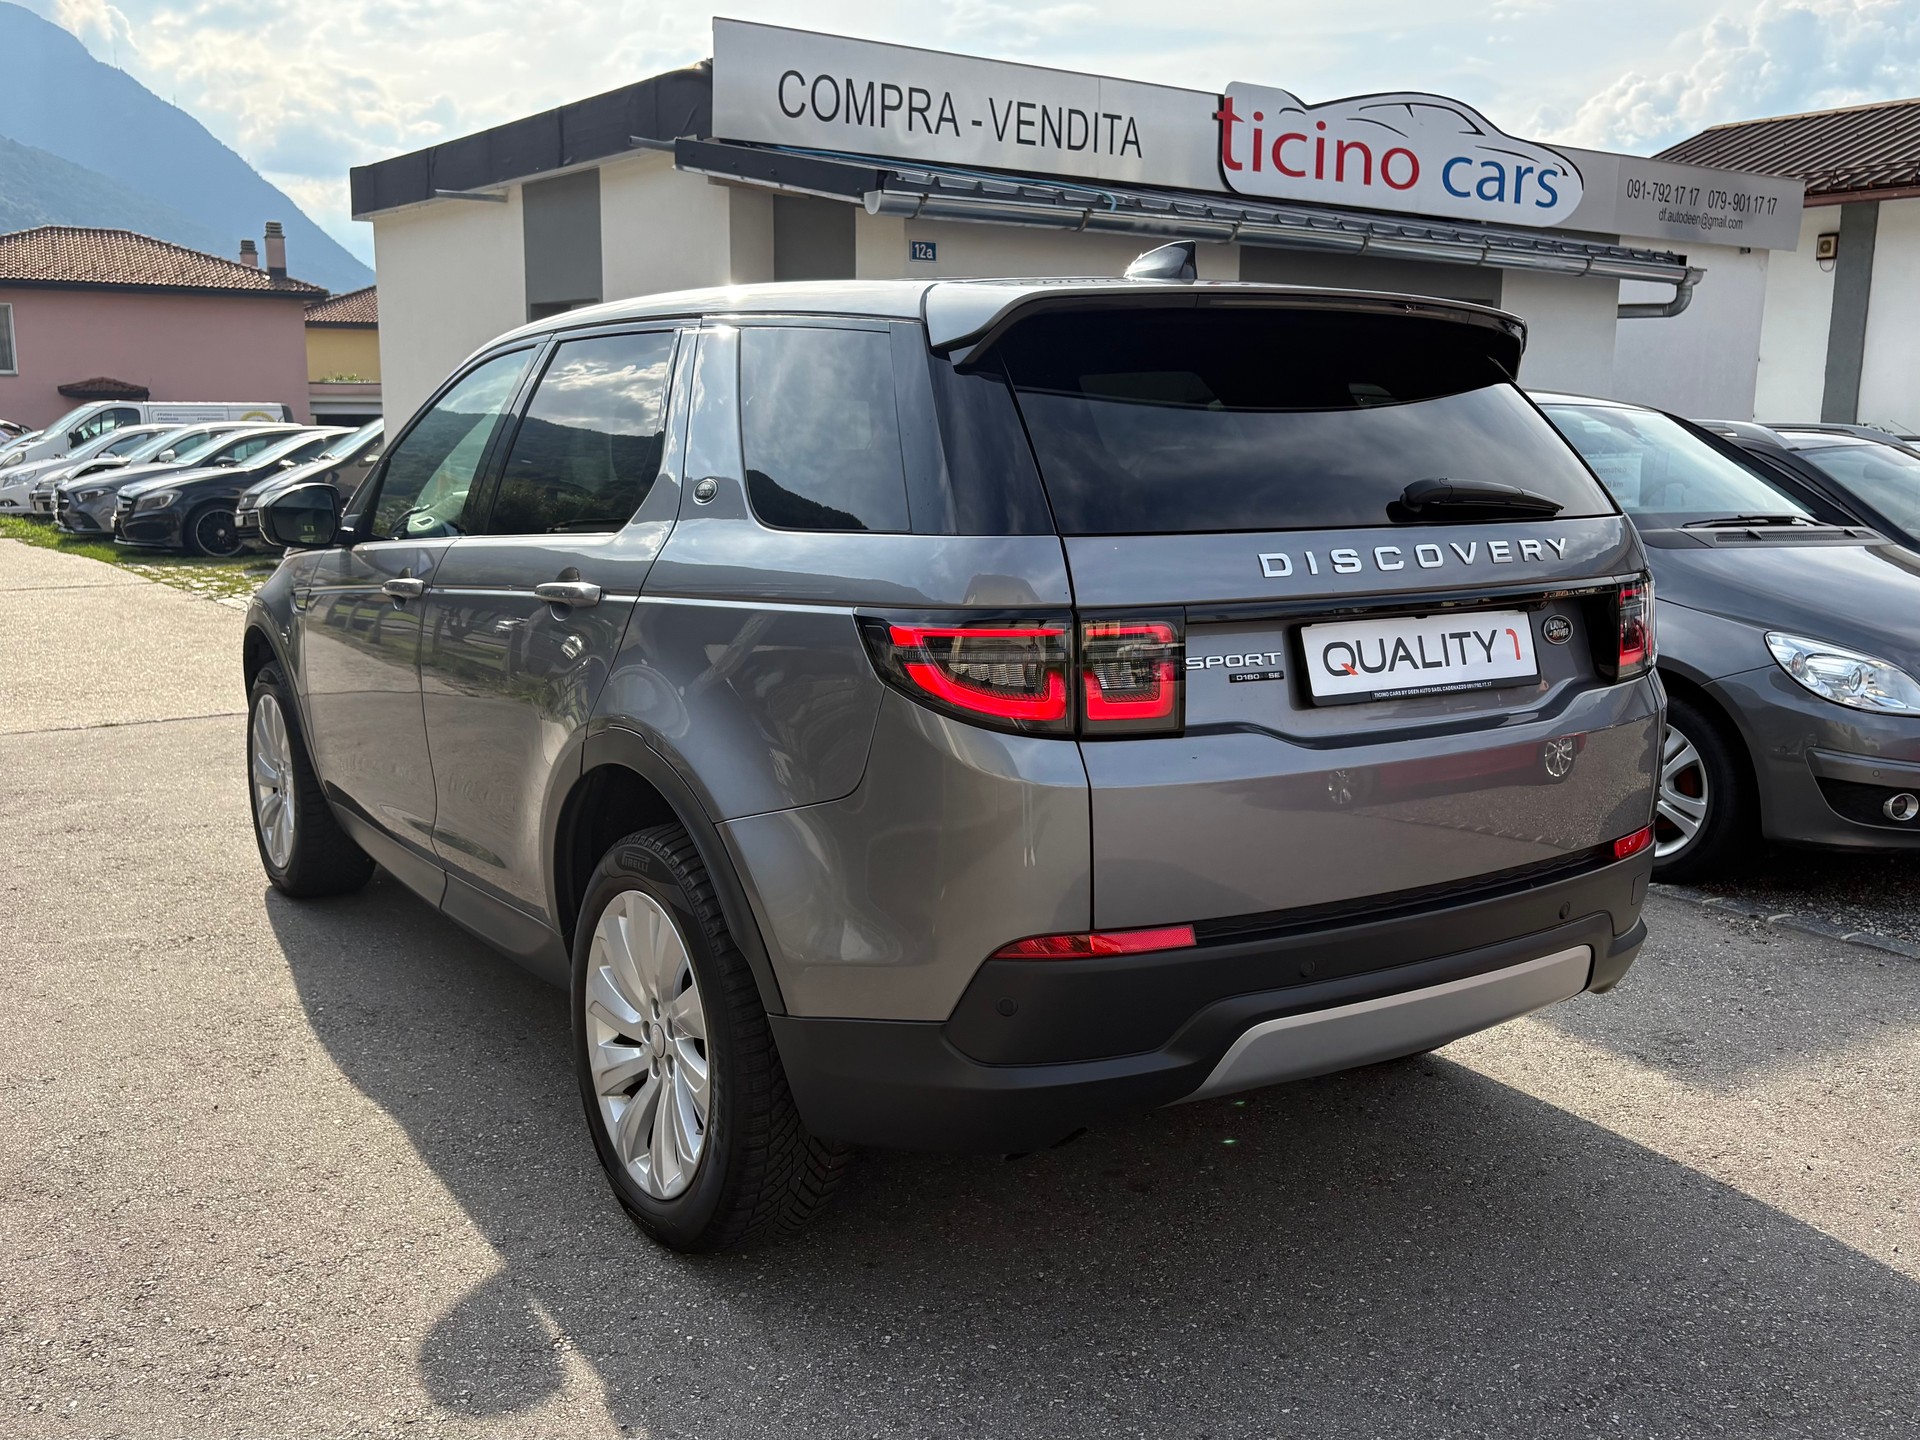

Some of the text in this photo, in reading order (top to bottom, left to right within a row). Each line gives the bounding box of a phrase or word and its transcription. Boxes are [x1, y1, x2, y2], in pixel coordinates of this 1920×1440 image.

[778, 69, 960, 138] COMPRA
[988, 97, 1143, 159] VENDITA
[1216, 96, 1560, 209] ticino cars
[1626, 179, 1672, 203] 091-792
[1674, 186, 1686, 205] 17
[1689, 188, 1700, 206] 17
[1708, 190, 1751, 213] 079-901
[1658, 208, 1744, 230] df.autodeen@gmail.com
[914, 244, 934, 259] 12a
[1258, 538, 1567, 578] DISCOVERY
[1185, 652, 1281, 670] SPORT
[1236, 673, 1260, 681] D180
